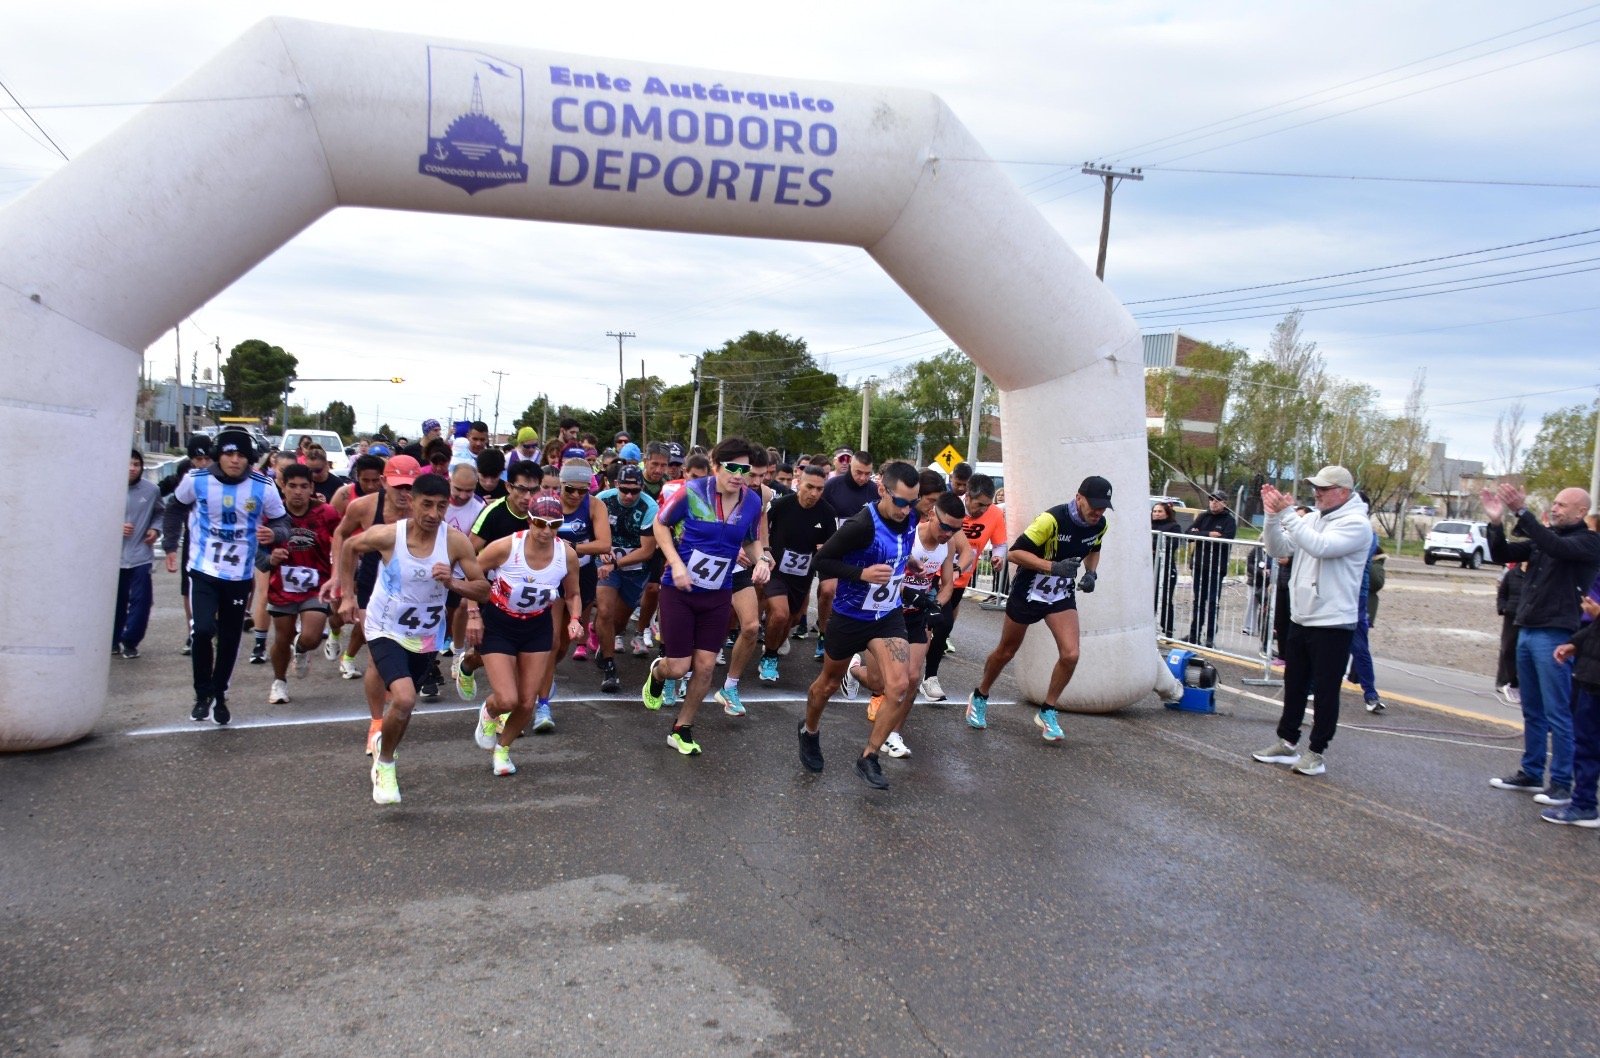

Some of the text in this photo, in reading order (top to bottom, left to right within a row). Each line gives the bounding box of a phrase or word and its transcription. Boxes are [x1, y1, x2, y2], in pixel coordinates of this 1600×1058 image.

[549, 66, 835, 113] Ente Autárquico
[551, 97, 838, 157] COMODORO
[424, 164, 522, 180] COMODORO RIVADAVIA
[548, 144, 835, 208] DEPORTES
[211, 541, 240, 567] 14
[784, 552, 810, 570] 32
[285, 568, 315, 588] 42
[692, 557, 728, 582] 47
[397, 605, 444, 630] 43
